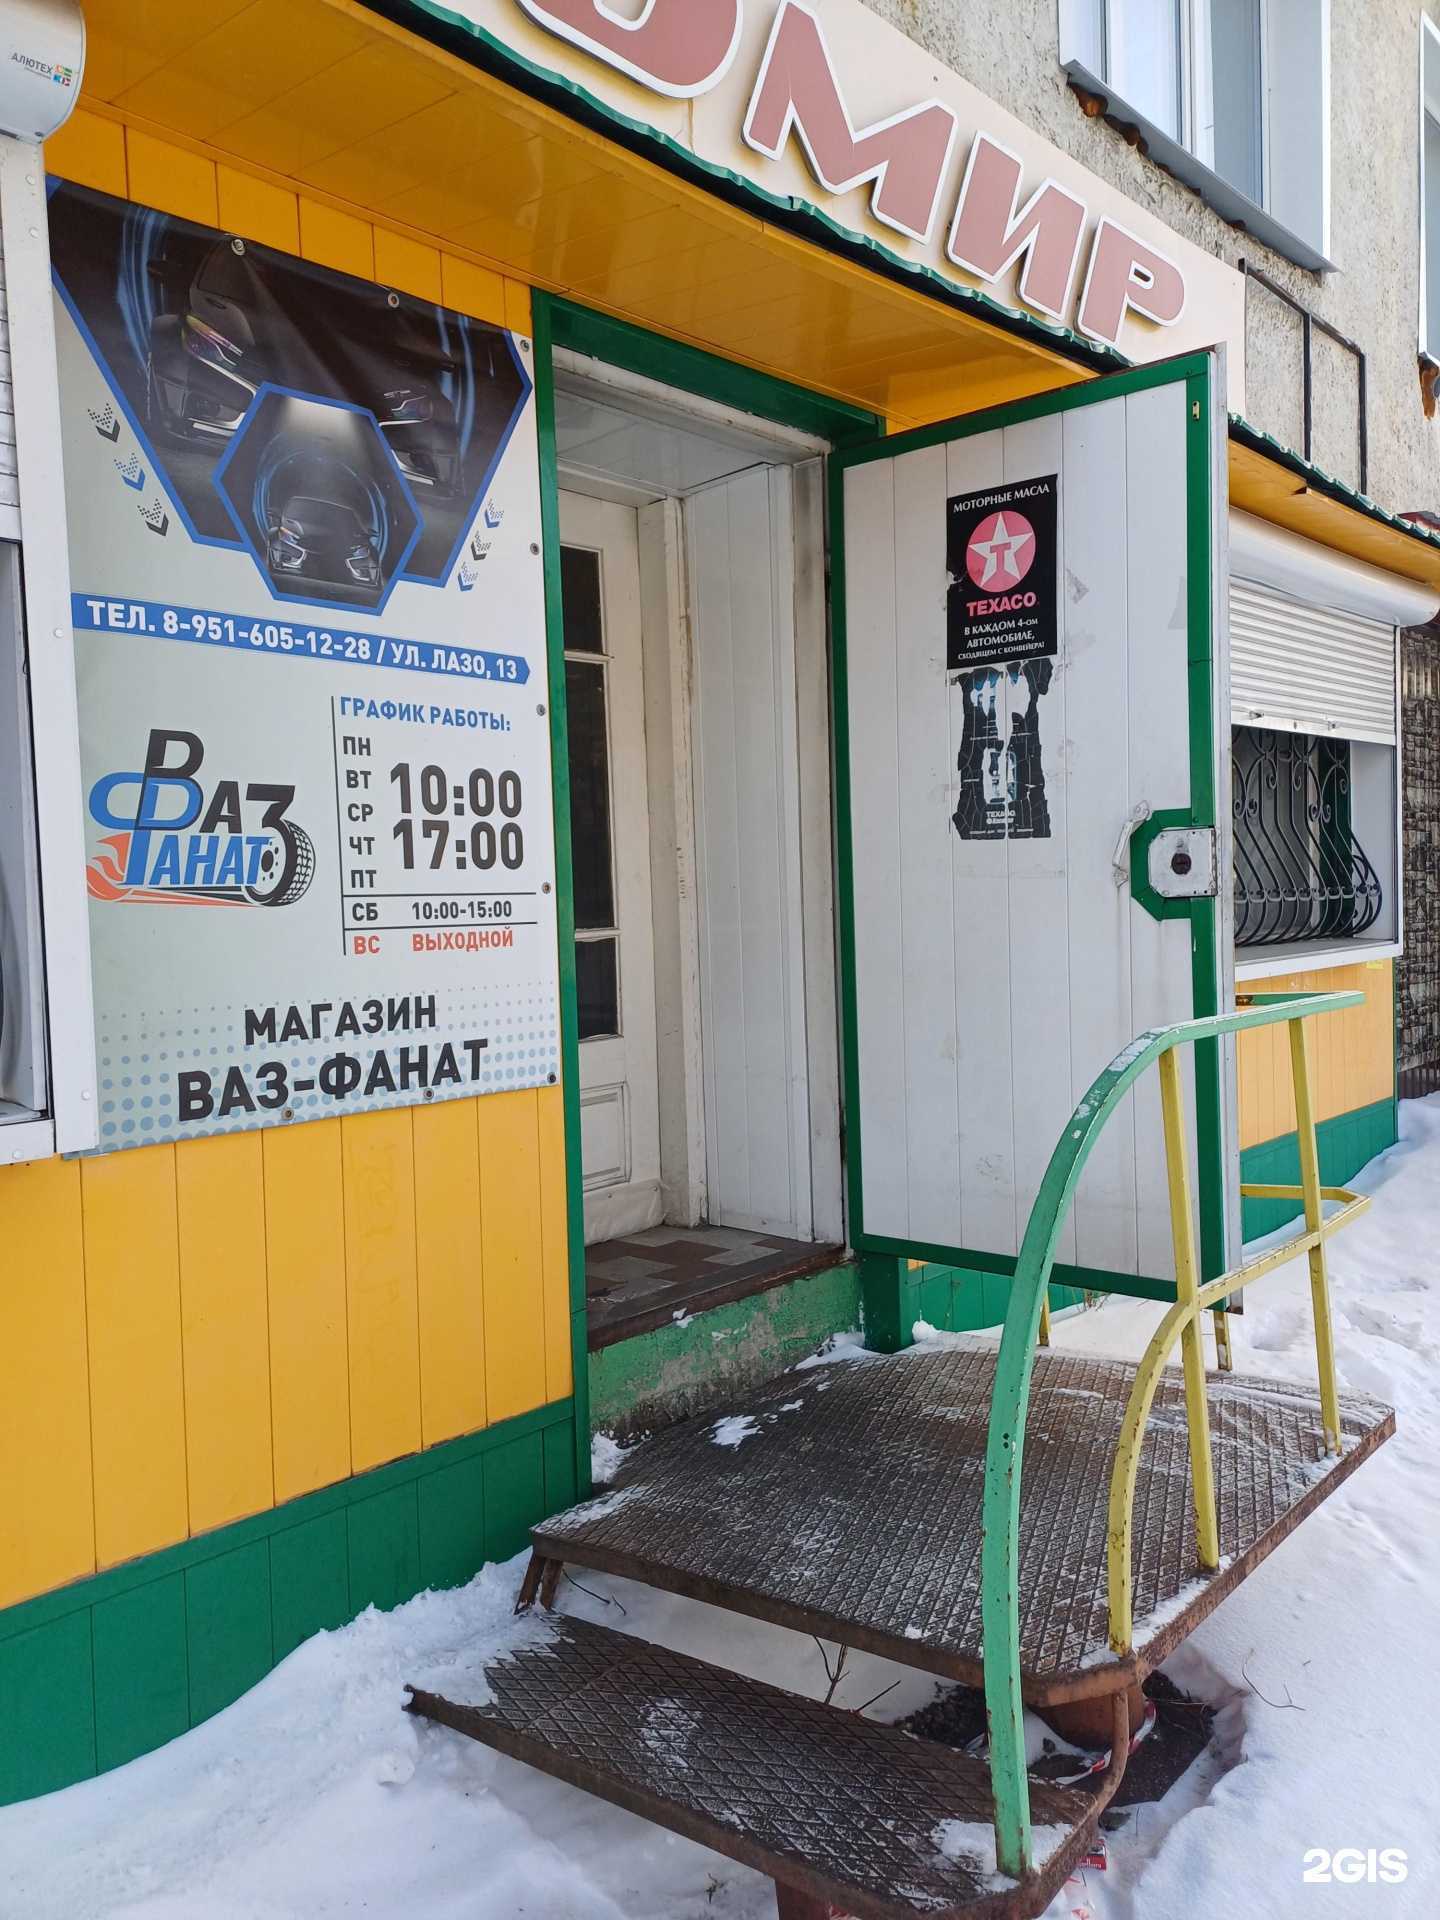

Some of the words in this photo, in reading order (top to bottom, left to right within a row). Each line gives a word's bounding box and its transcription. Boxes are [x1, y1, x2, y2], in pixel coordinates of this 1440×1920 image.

[11, 52, 53, 75] АЛЮТЕХ
[953, 492, 1012, 513] МОТОРНЫЕ
[1013, 483, 1050, 500] МАСЛА
[966, 592, 1037, 617] TEXACO
[964, 627, 970, 635] В
[972, 620, 1015, 634] КАЖДОМ
[966, 630, 1035, 648] АВТОМОБИЛЕ,
[86, 600, 155, 632] ТЕЛ.
[163, 610, 371, 660] 8-951-605-12-28
[391, 642, 426, 668] УЛ.
[431, 649, 491, 680] ЛАЗО,
[496, 658, 517, 680] 13
[340, 696, 425, 723] ГРАФИК
[430, 706, 511, 731] РАБОТЫ:
[342, 736, 371, 756] ПН
[346, 769, 372, 789] ВТ
[390, 762, 522, 818] 10:00
[347, 803, 374, 822] СР
[349, 836, 375, 855] ЧТ
[393, 818, 524, 870] 17:00
[350, 869, 377, 889] ПТ
[352, 902, 378, 922] СБ
[412, 900, 512, 920] 10:00-15:00
[353, 935, 381, 955] ВС
[411, 925, 514, 952] ВЫХОДНОЙ
[244, 994, 436, 1046] МАГАЗИН
[177, 1038, 488, 1122] ВАЗ-ФАНАТ
